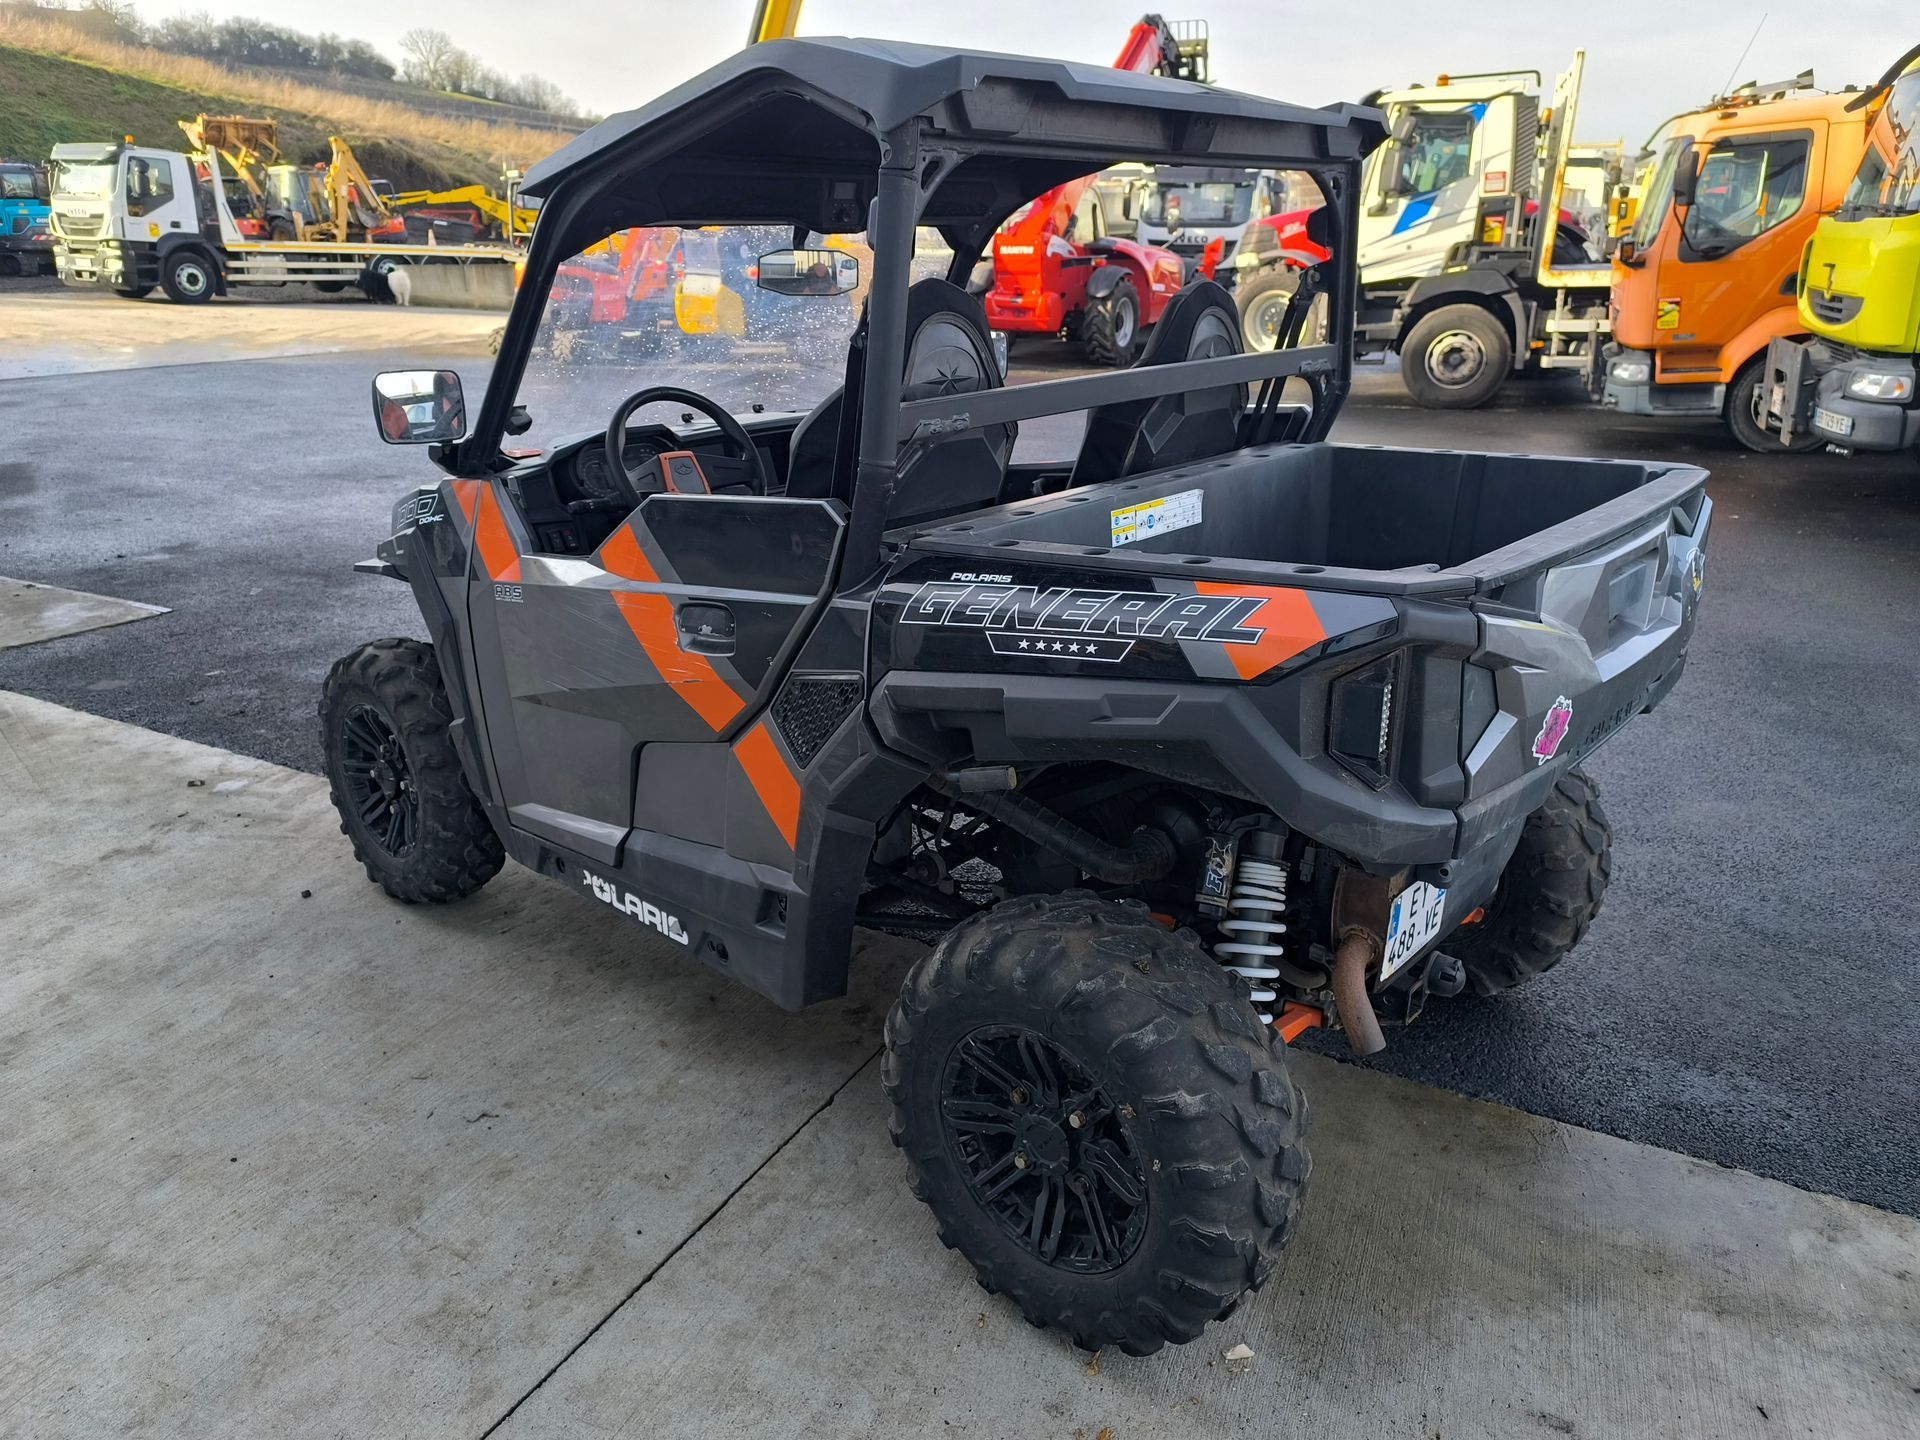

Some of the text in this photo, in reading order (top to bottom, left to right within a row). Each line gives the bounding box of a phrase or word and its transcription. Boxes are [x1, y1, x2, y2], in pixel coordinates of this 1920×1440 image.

[950, 572, 1013, 583] POLARIS
[495, 584, 523, 599] ABS
[899, 581, 1270, 644] GENERAL
